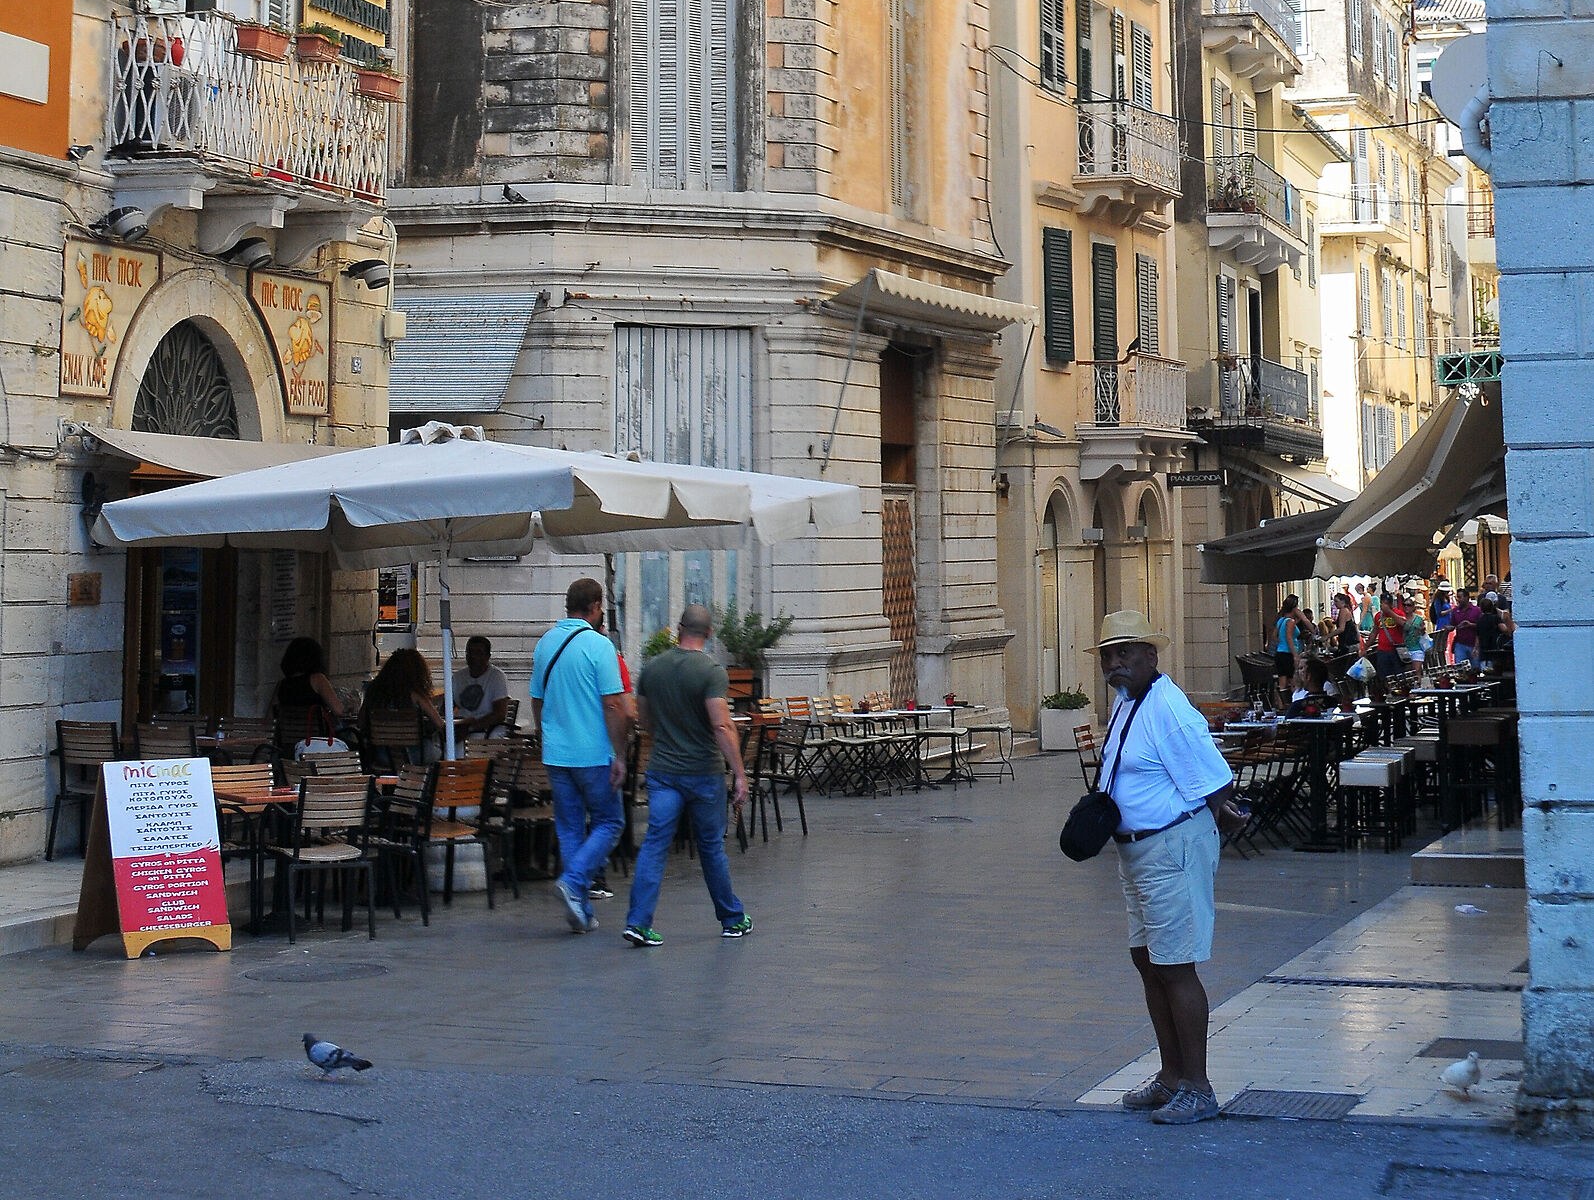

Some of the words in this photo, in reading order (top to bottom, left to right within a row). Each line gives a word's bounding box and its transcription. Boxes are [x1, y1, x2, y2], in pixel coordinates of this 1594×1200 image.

[290, 379, 306, 407] FAST
[308, 379, 326, 408] FOOD
[1170, 474, 1222, 482] PIANEGONDA
[129, 794, 193, 802] ΚΟΤΟΠΟΥΛΟ
[135, 811, 192, 820] ΣΑΝΤΟΥΙΤΣ
[146, 820, 182, 828] ΚΛΑΜΠ
[136, 825, 193, 834] ΣΑΝΤΟΥΙΤΣ
[143, 834, 189, 842] ΣΑΛΑΤΕΣ
[130, 860, 163, 868] GYROS
[176, 857, 206, 865] PITTA
[131, 868, 173, 877] CHICKEN
[175, 866, 207, 874] GYROS
[133, 883, 165, 891] GYROS
[167, 880, 209, 889] PORTION
[146, 890, 198, 899] SANDWICH
[147, 904, 200, 914] SANDWICH
[157, 913, 193, 922] SALADS
[140, 920, 212, 932] CHEESEBURGER
